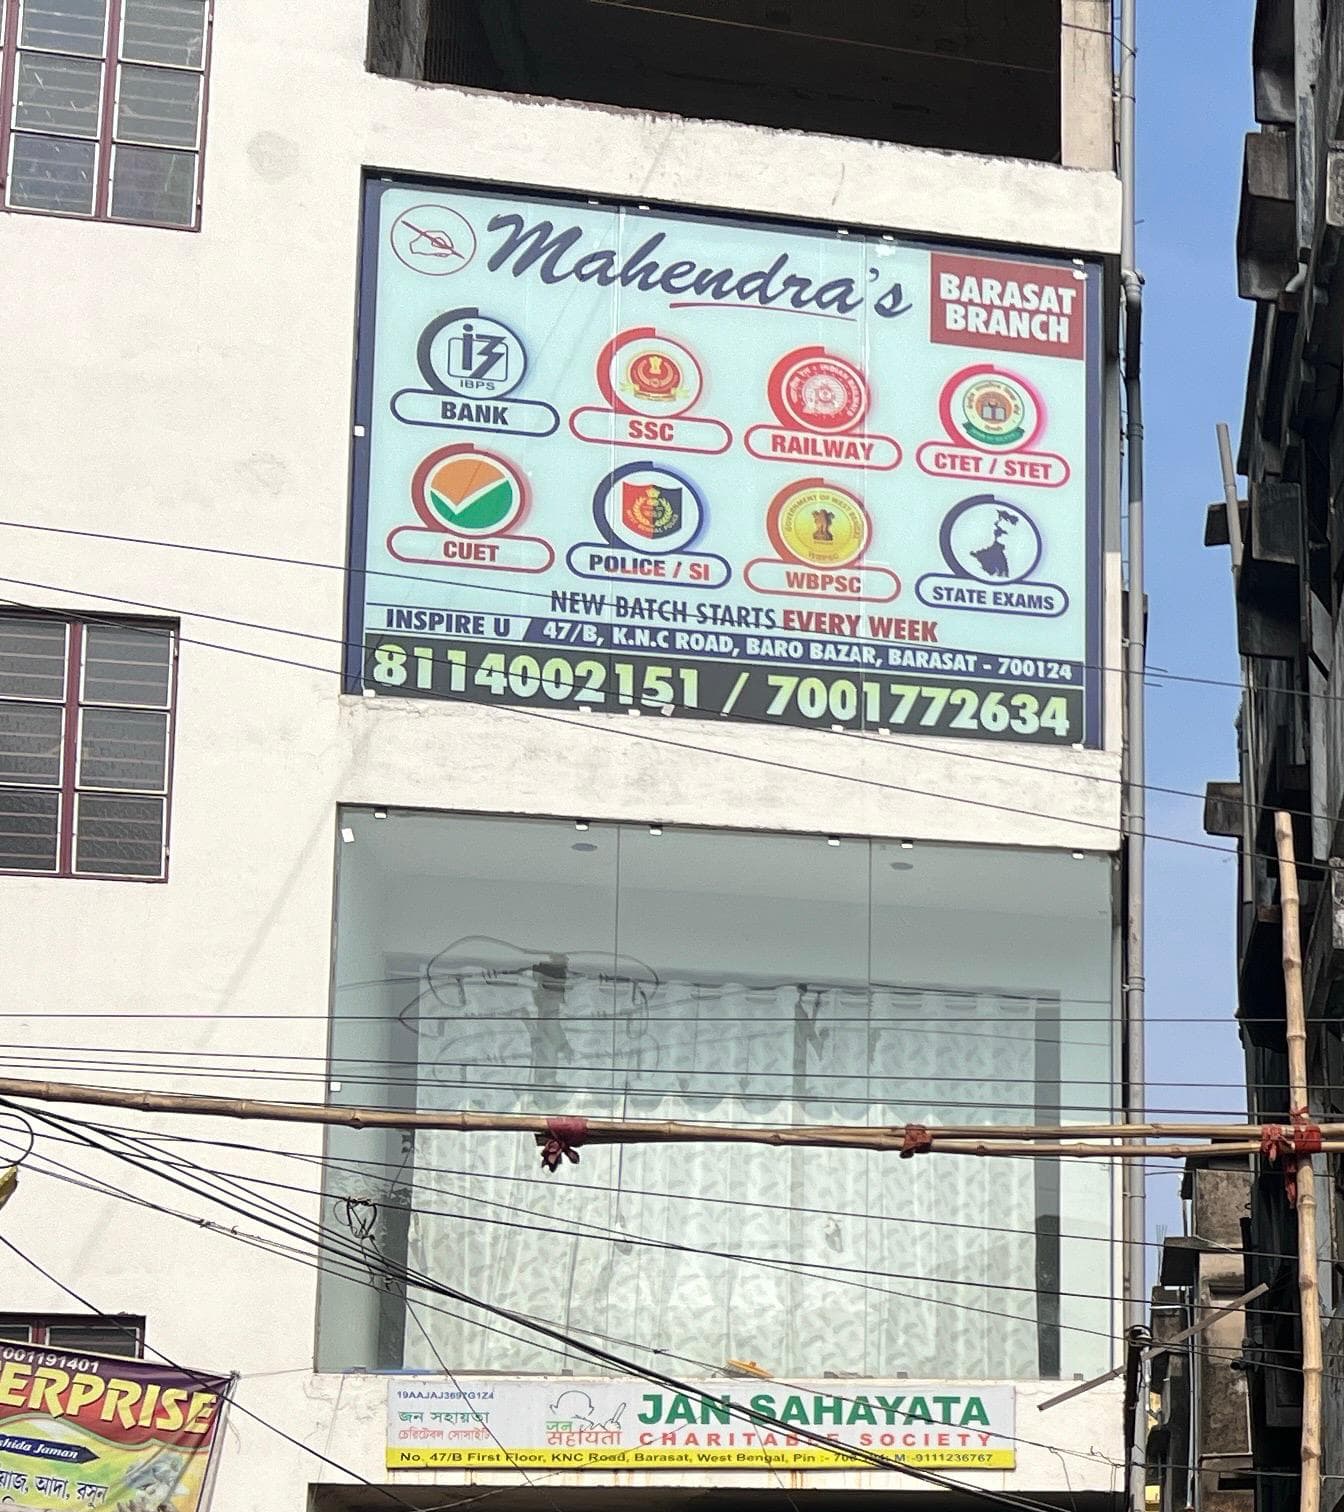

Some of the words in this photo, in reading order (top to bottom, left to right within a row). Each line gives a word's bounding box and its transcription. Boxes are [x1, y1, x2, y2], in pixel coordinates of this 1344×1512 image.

[486, 212, 913, 317] Mahendra's
[939, 271, 1077, 317] BARASAT
[945, 304, 1070, 344] BRANCH
[460, 380, 496, 391] IBPS
[441, 400, 509, 426] BANK
[629, 420, 674, 442] SSC
[771, 434, 874, 461] RAILWAY
[934, 452, 983, 474] CTET
[987, 456, 997, 477] /
[1004, 457, 1053, 480] STET
[442, 539, 500, 563] CUET
[589, 552, 667, 577] POLICE
[673, 560, 683, 580] /
[689, 561, 711, 582] SI
[784, 569, 863, 595] WBPSC
[932, 586, 986, 606] STATE
[991, 589, 1055, 611] EXAMS
[385, 607, 486, 637] INSPIRE
[491, 617, 511, 638] U
[550, 588, 606, 615] NEW
[615, 595, 689, 623] BATCH
[695, 602, 777, 630] STARTS
[782, 611, 862, 638] EVERY
[868, 617, 939, 644] WEEK
[542, 621, 605, 647] 47/B,
[612, 627, 671, 650] K.N.C
[675, 630, 740, 659] ROAD,
[745, 637, 805, 662] BARO
[811, 641, 883, 669] BAZAR,
[887, 648, 977, 674] BARASAT
[997, 656, 1073, 681] 700124
[371, 645, 701, 711] 8114002151
[720, 672, 748, 717] /
[766, 673, 1070, 737] 7001772634
[0, 1360, 217, 1434] ERPRISE
[638, 1394, 731, 1426] JAN
[750, 1394, 991, 1426] SAHAYATA
[398, 1412, 425, 1424] জন
[33, 1442, 79, 1460] Jaman
[860, 1432, 993, 1447] SOCIETY
[430, 1452, 462, 1463] 47/B
[467, 1452, 502, 1463] First
[505, 1452, 547, 1464] Floor,
[551, 1452, 585, 1463] KNC
[634, 1452, 692, 1464] Barasat,
[697, 1453, 733, 1463] West
[736, 1453, 786, 1465] Bengal,
[793, 1453, 816, 1463] Pin
